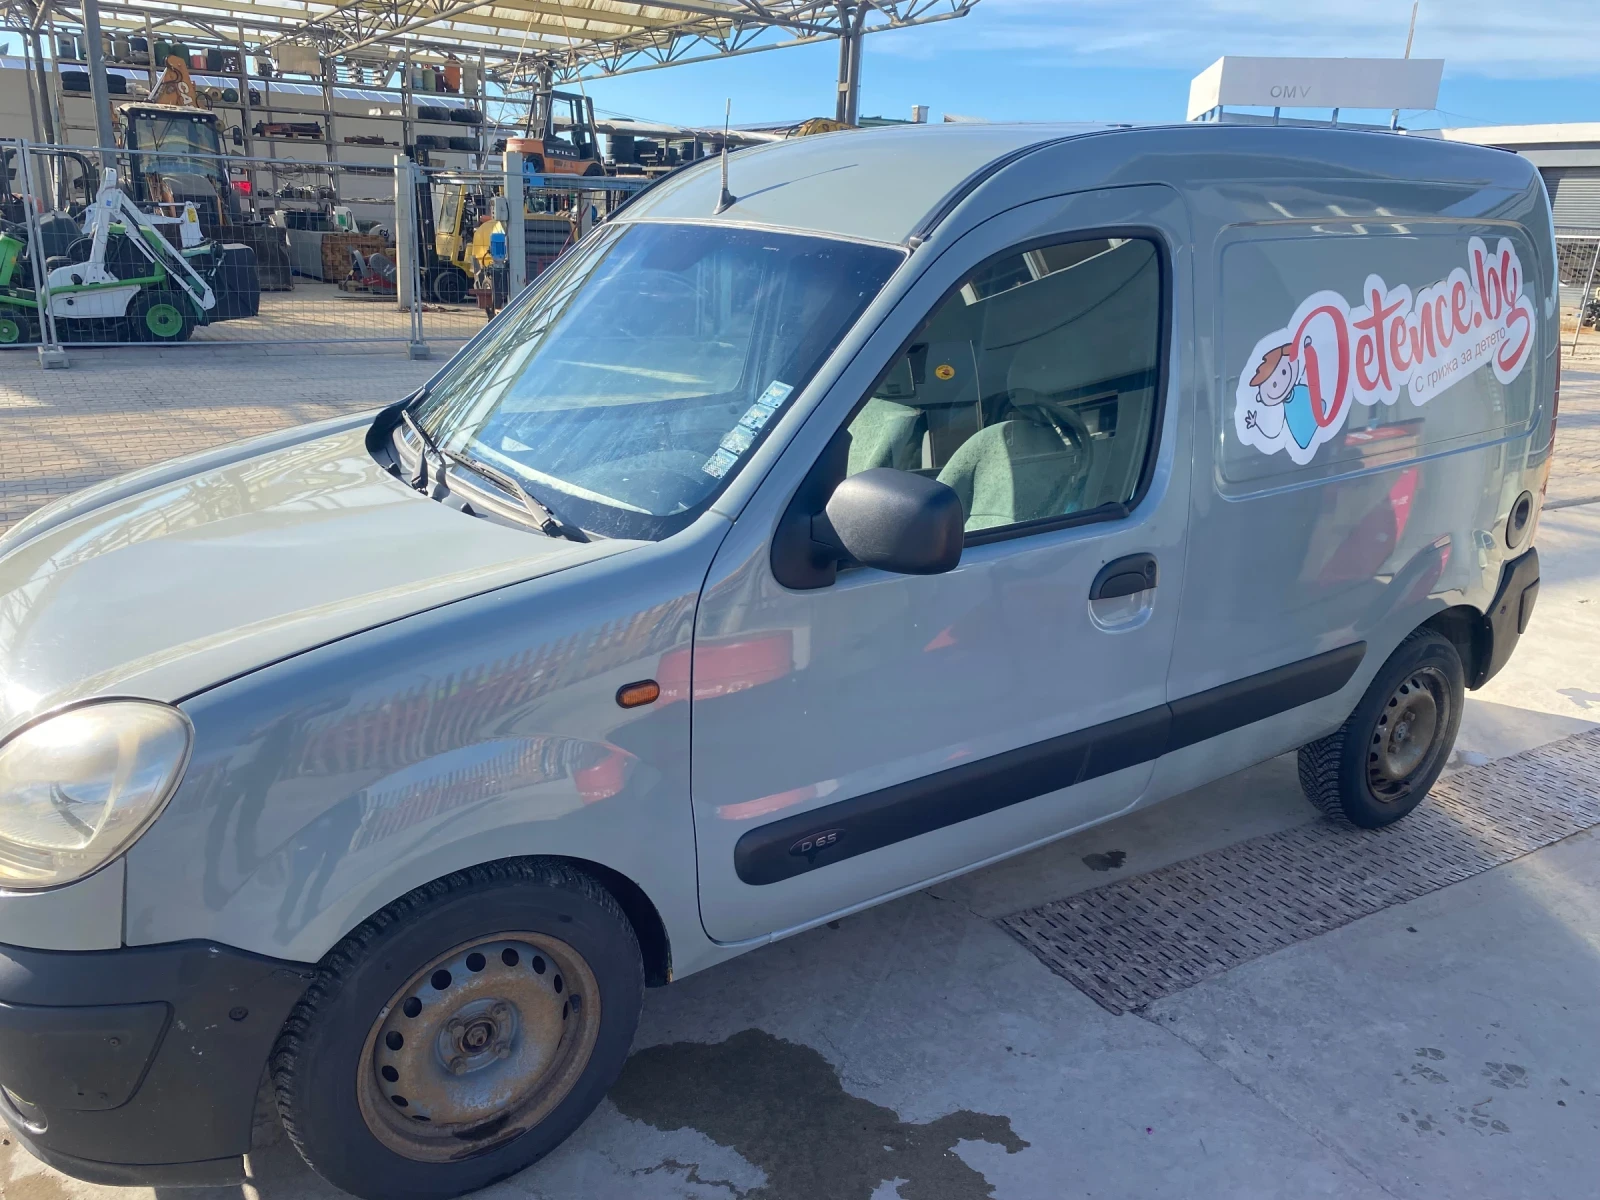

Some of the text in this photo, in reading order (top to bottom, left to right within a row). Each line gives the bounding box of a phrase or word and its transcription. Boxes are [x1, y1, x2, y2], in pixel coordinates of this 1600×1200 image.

[1270, 85, 1312, 98] OMV
[547, 148, 577, 157] STILL
[1289, 249, 1531, 428] Detence.bg
[1427, 357, 1459, 388] грижа
[1460, 348, 1473, 365] за
[1475, 326, 1506, 360] детето
